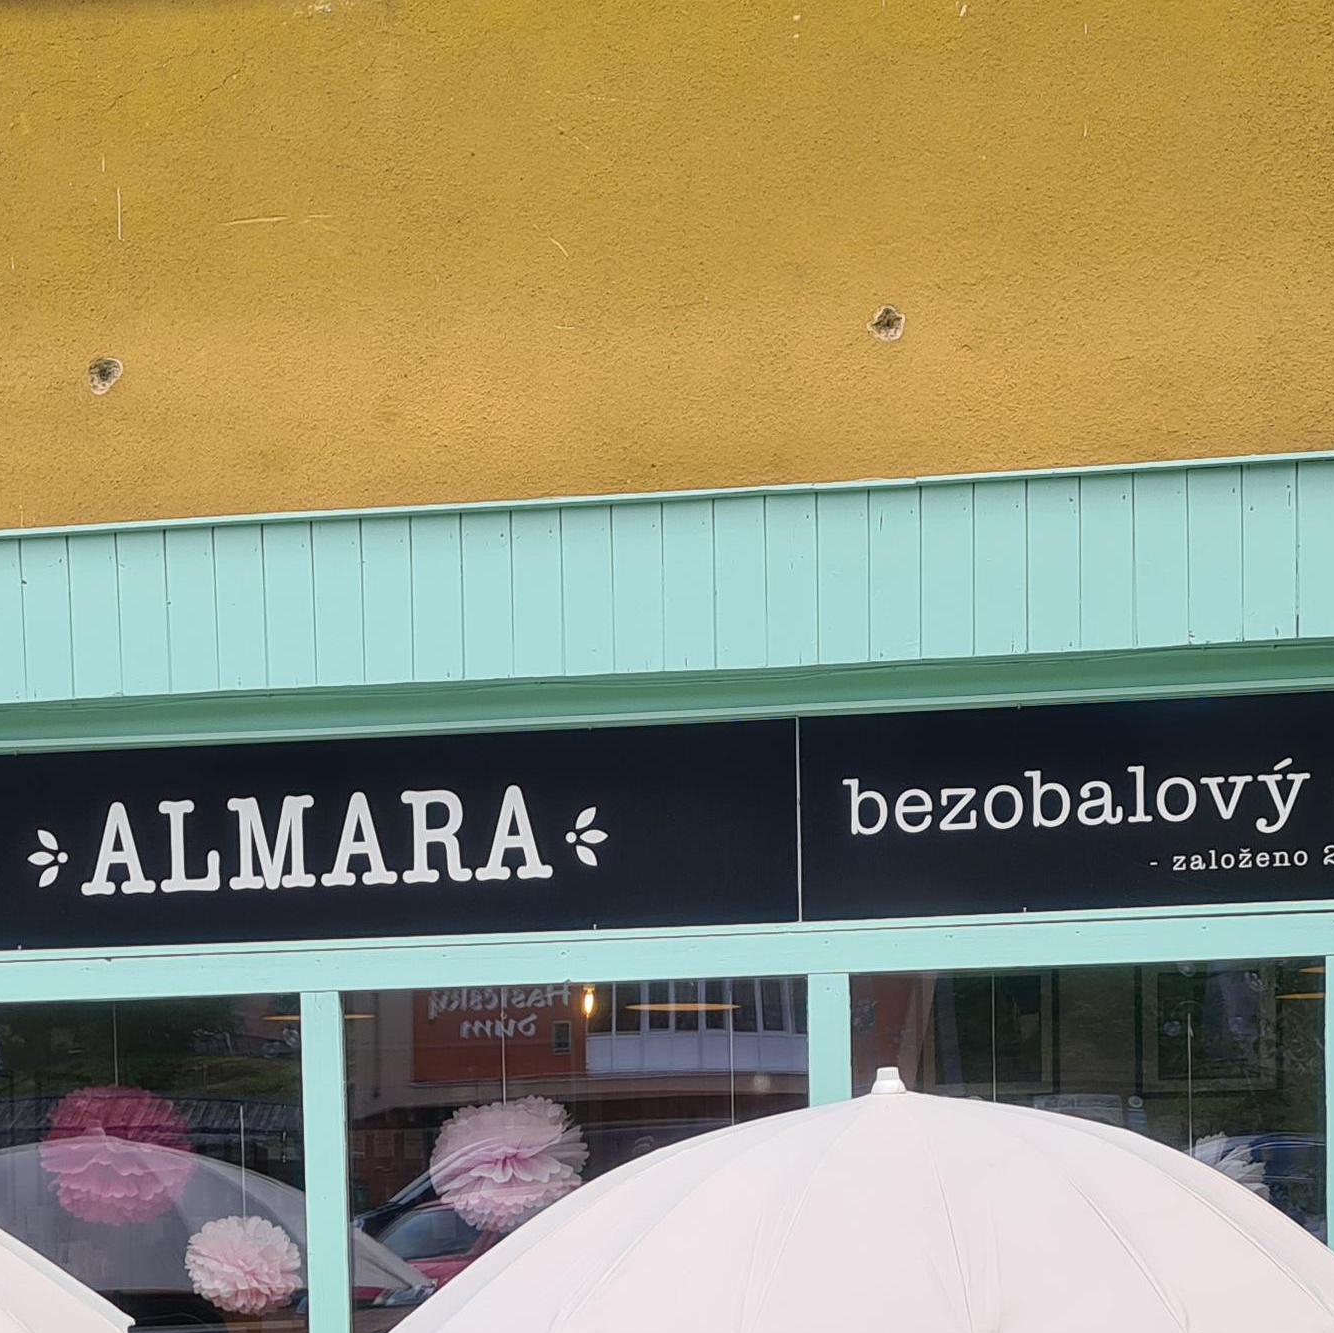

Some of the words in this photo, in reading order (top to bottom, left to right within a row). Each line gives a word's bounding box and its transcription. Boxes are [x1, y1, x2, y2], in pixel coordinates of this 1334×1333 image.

[842, 757, 1311, 836] bezobalový
[80, 784, 554, 896] ALMARA
[1172, 848, 1308, 871] založeno
